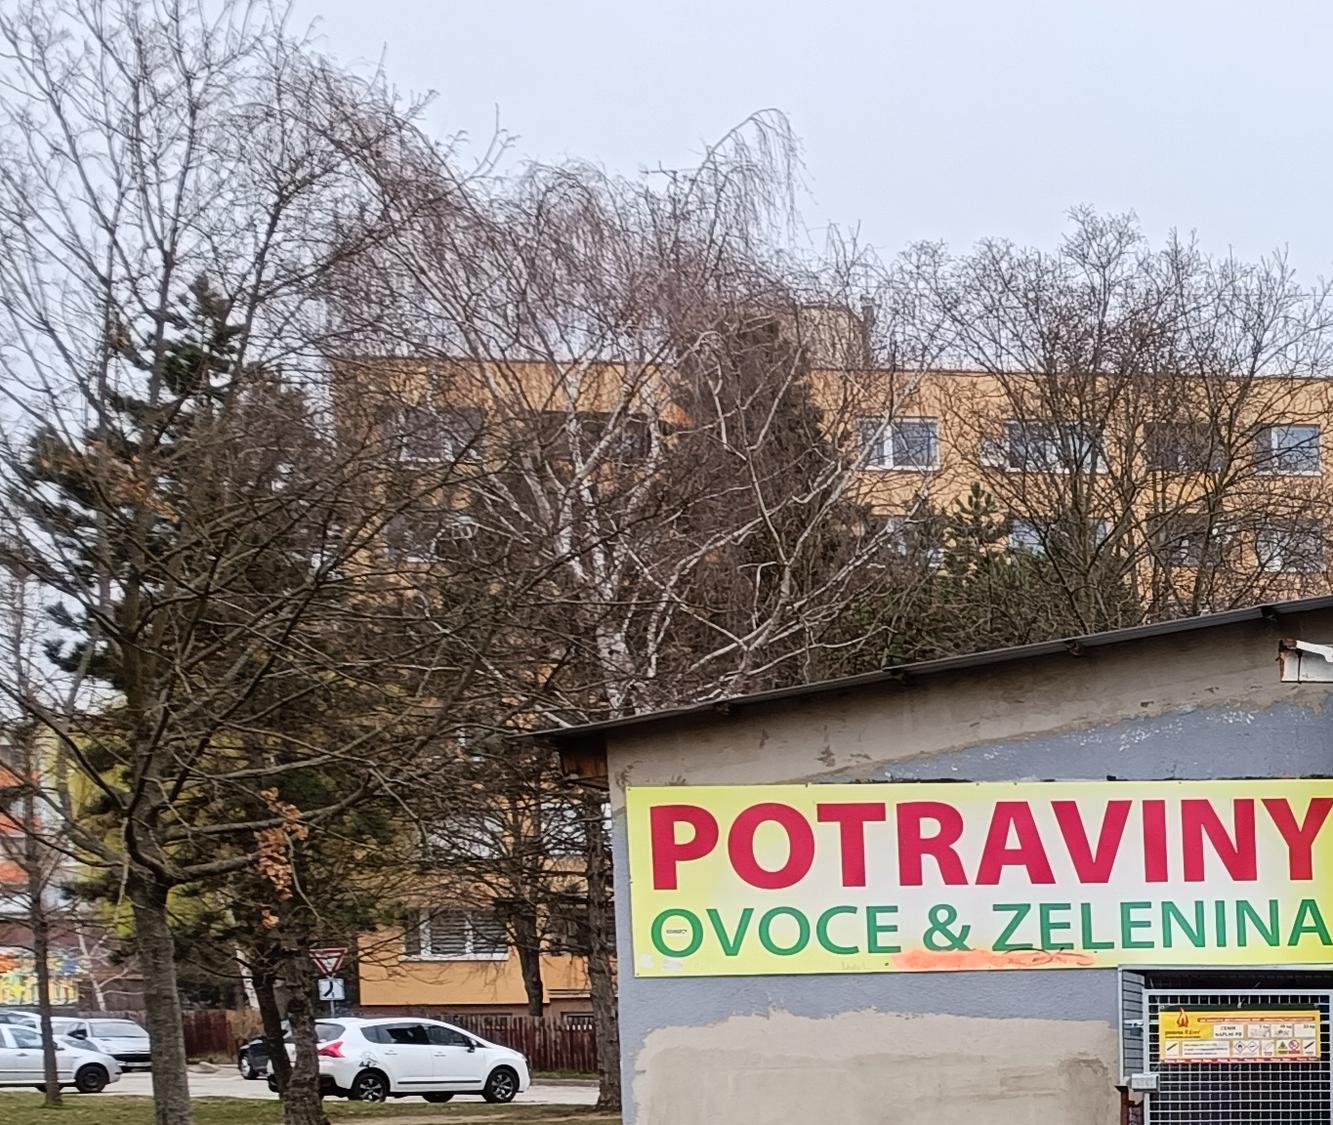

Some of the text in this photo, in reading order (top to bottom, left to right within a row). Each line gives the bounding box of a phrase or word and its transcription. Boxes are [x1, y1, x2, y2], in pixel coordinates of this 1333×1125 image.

[651, 899, 1333, 958] OVOCE & ZELENINA
